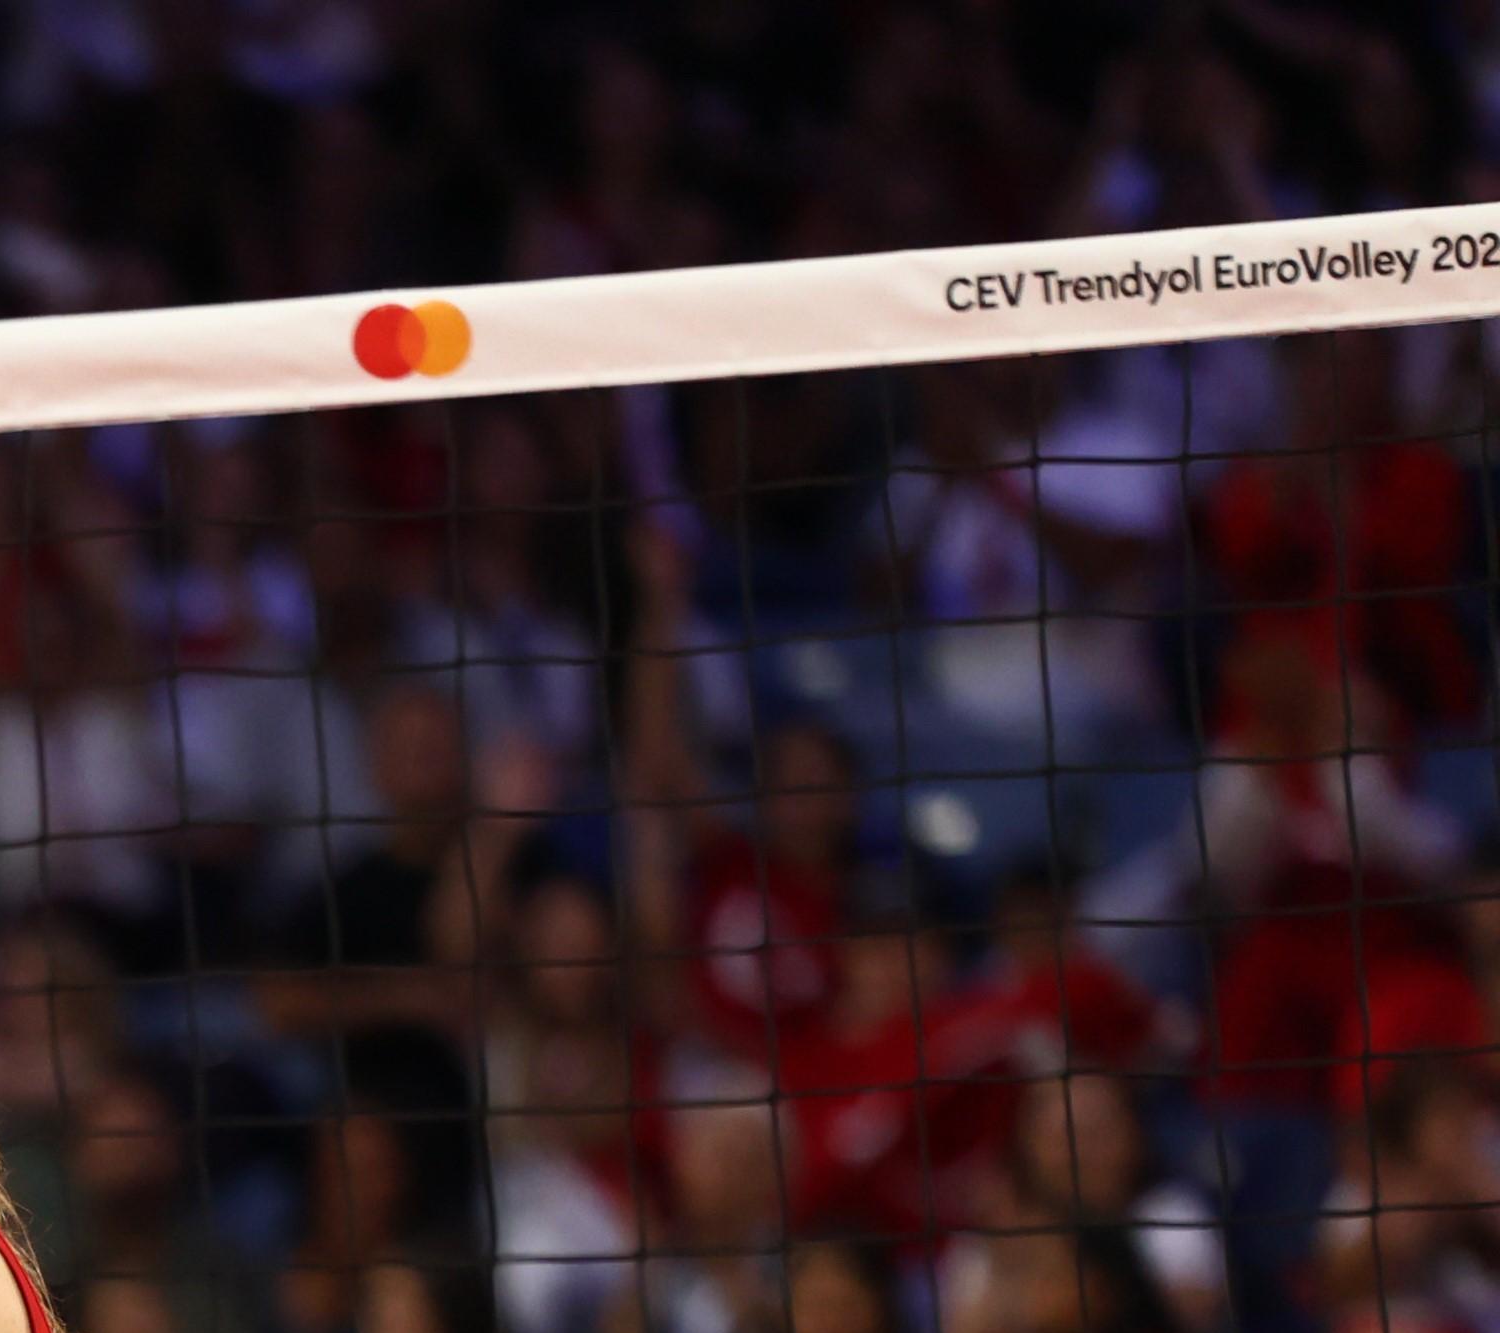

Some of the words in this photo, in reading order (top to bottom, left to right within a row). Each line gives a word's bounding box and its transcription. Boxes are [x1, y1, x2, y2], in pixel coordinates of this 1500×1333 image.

[944, 270, 1025, 313] CEV
[1032, 254, 1203, 307] Trendyol
[1212, 239, 1420, 292] EuroVolley
